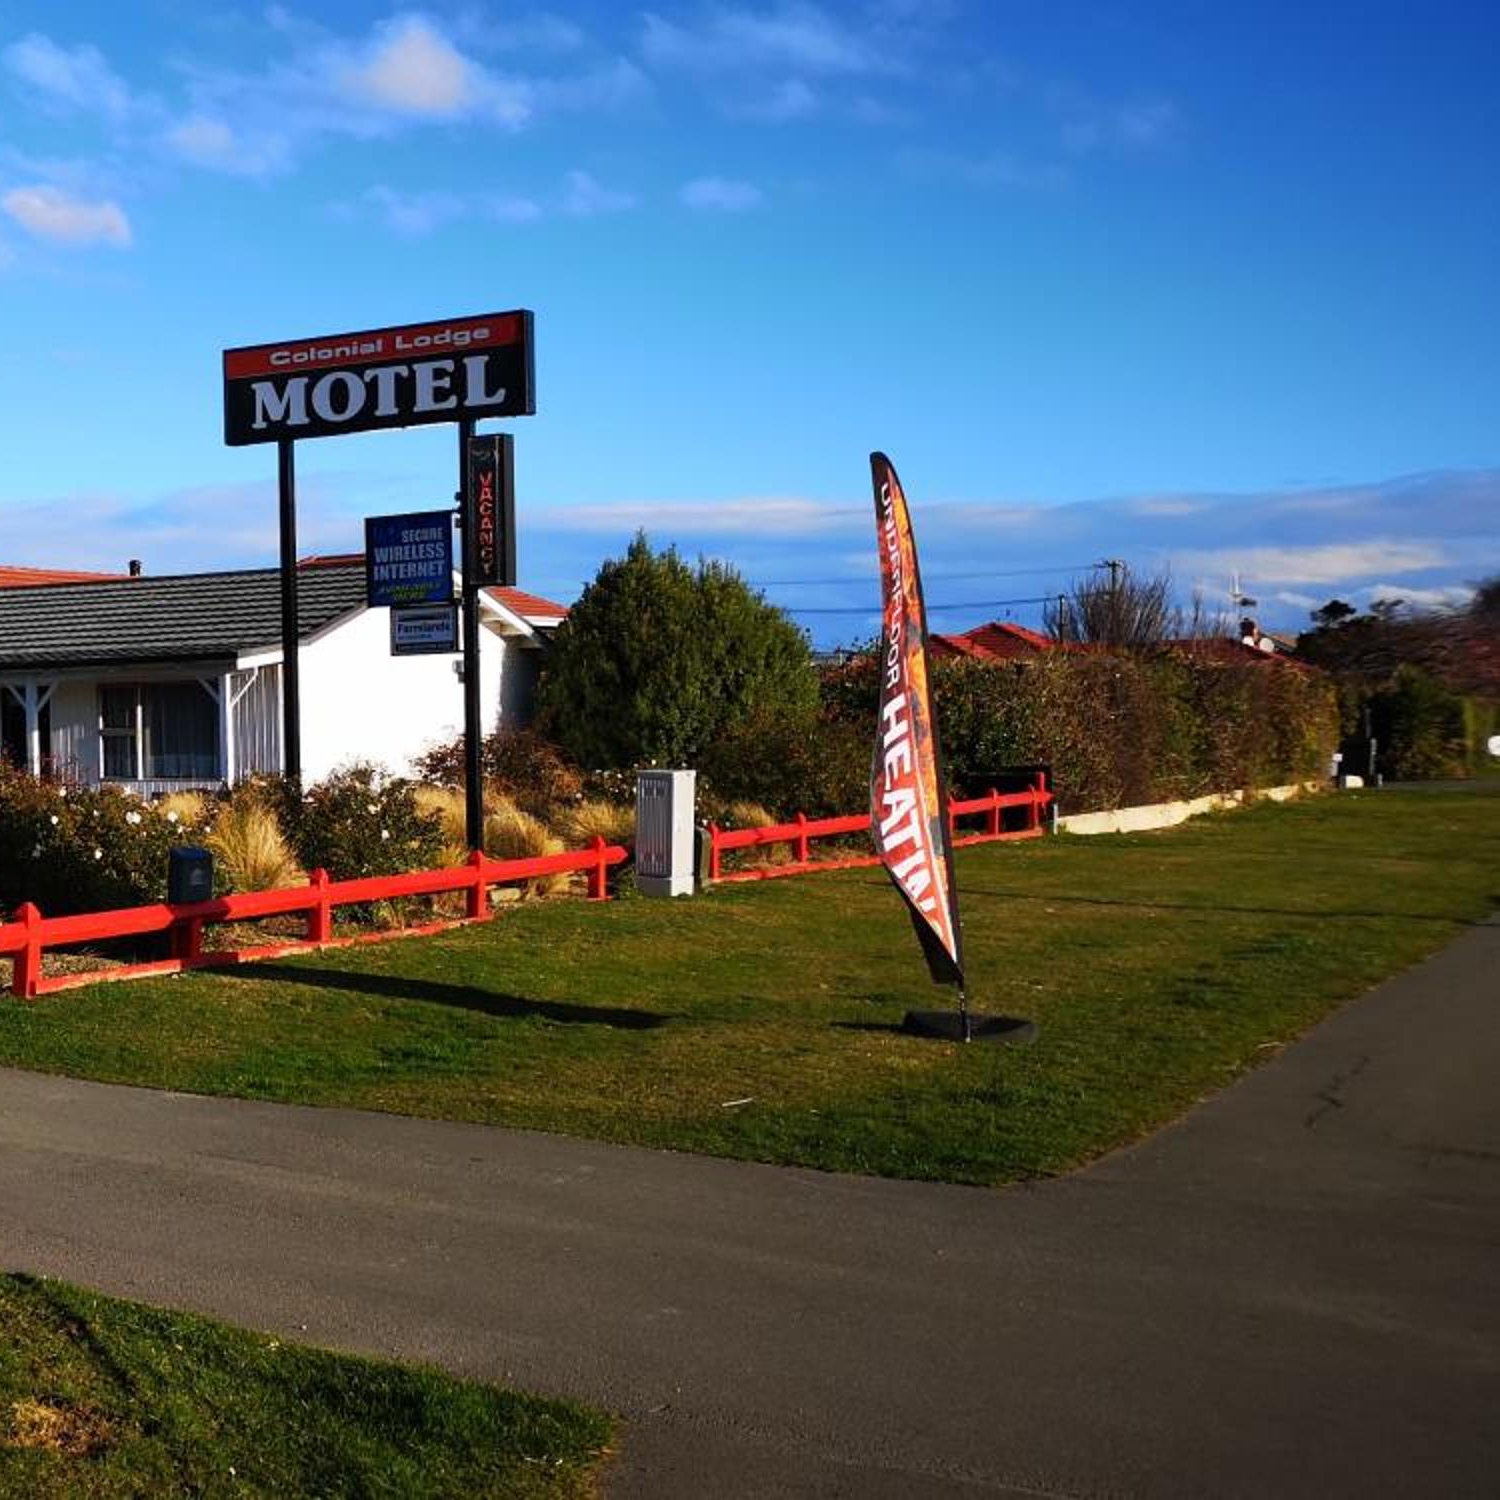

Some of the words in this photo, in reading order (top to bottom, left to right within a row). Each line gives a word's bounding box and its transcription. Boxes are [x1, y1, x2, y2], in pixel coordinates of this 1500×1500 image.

[269, 339, 382, 365] Colonial
[395, 328, 490, 348] Lodge
[252, 355, 505, 429] MOTEL
[402, 528, 443, 543] SECURE
[480, 472, 492, 575] VACANCY
[374, 543, 445, 563] WIRELESS
[374, 561, 445, 580] INTERNET
[881, 484, 902, 688] UNDERFLOOR
